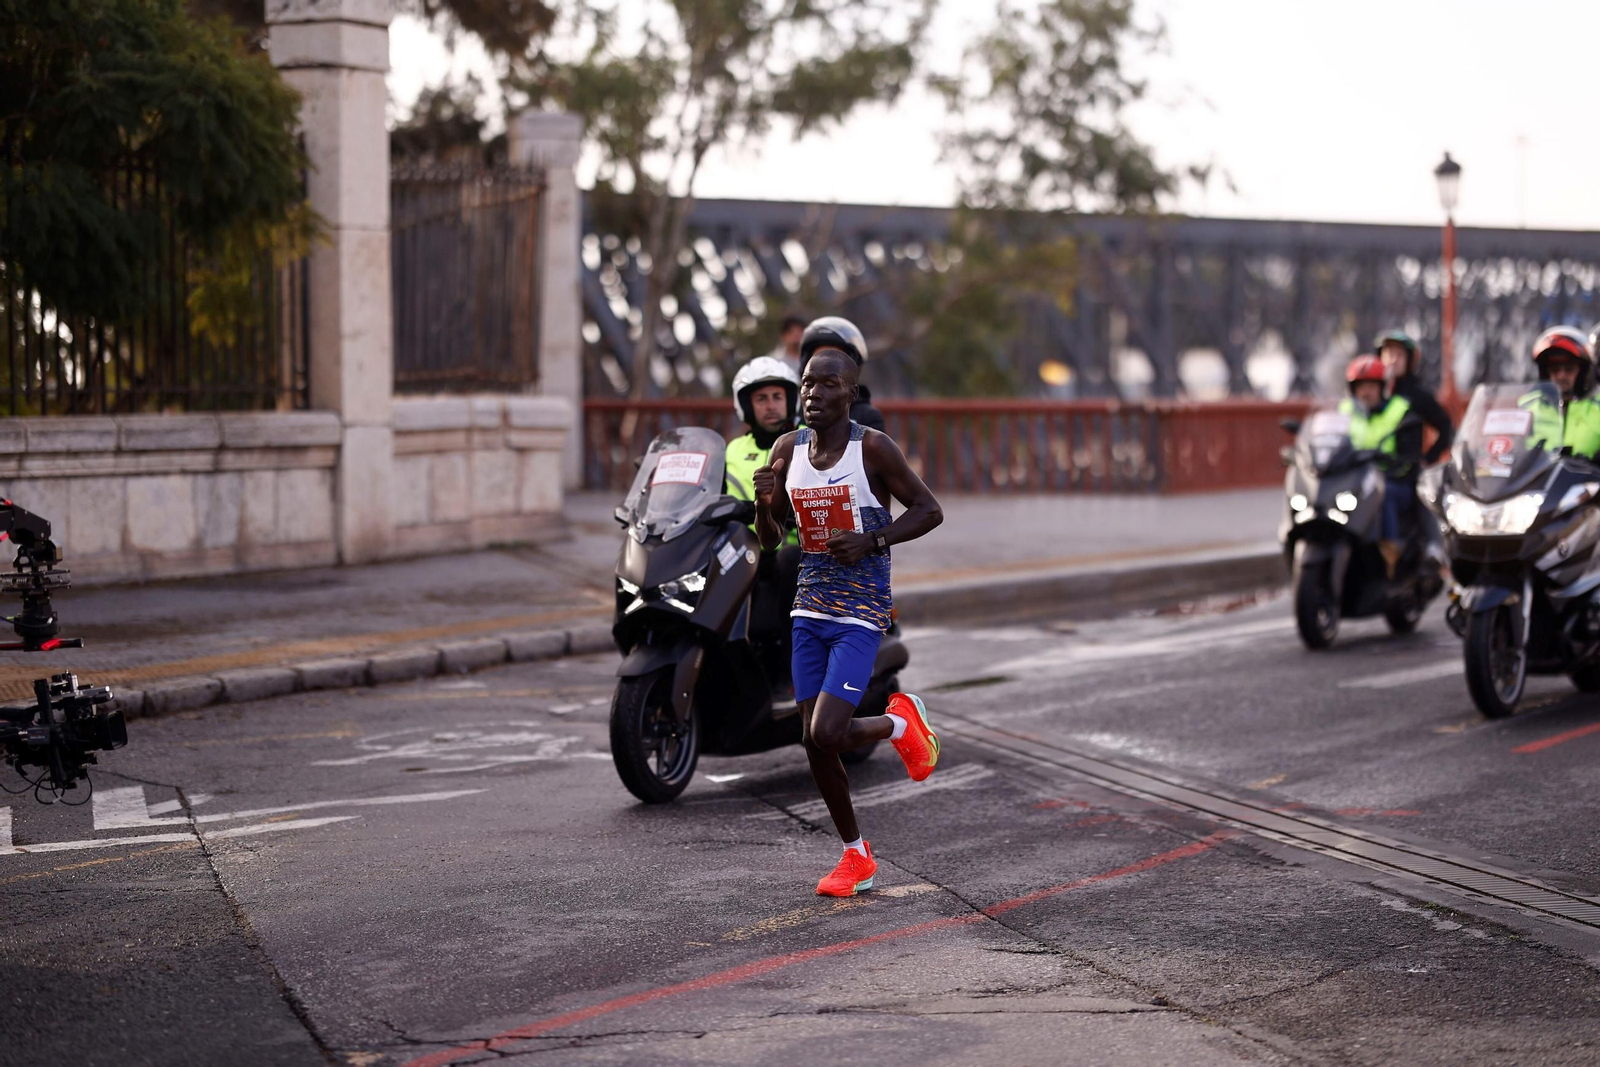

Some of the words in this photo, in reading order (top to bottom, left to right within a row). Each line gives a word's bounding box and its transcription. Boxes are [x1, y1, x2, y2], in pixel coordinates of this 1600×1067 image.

[804, 487, 844, 498] GENERALI
[803, 499, 834, 508] BUSHEN-
[811, 510, 828, 518] DICH
